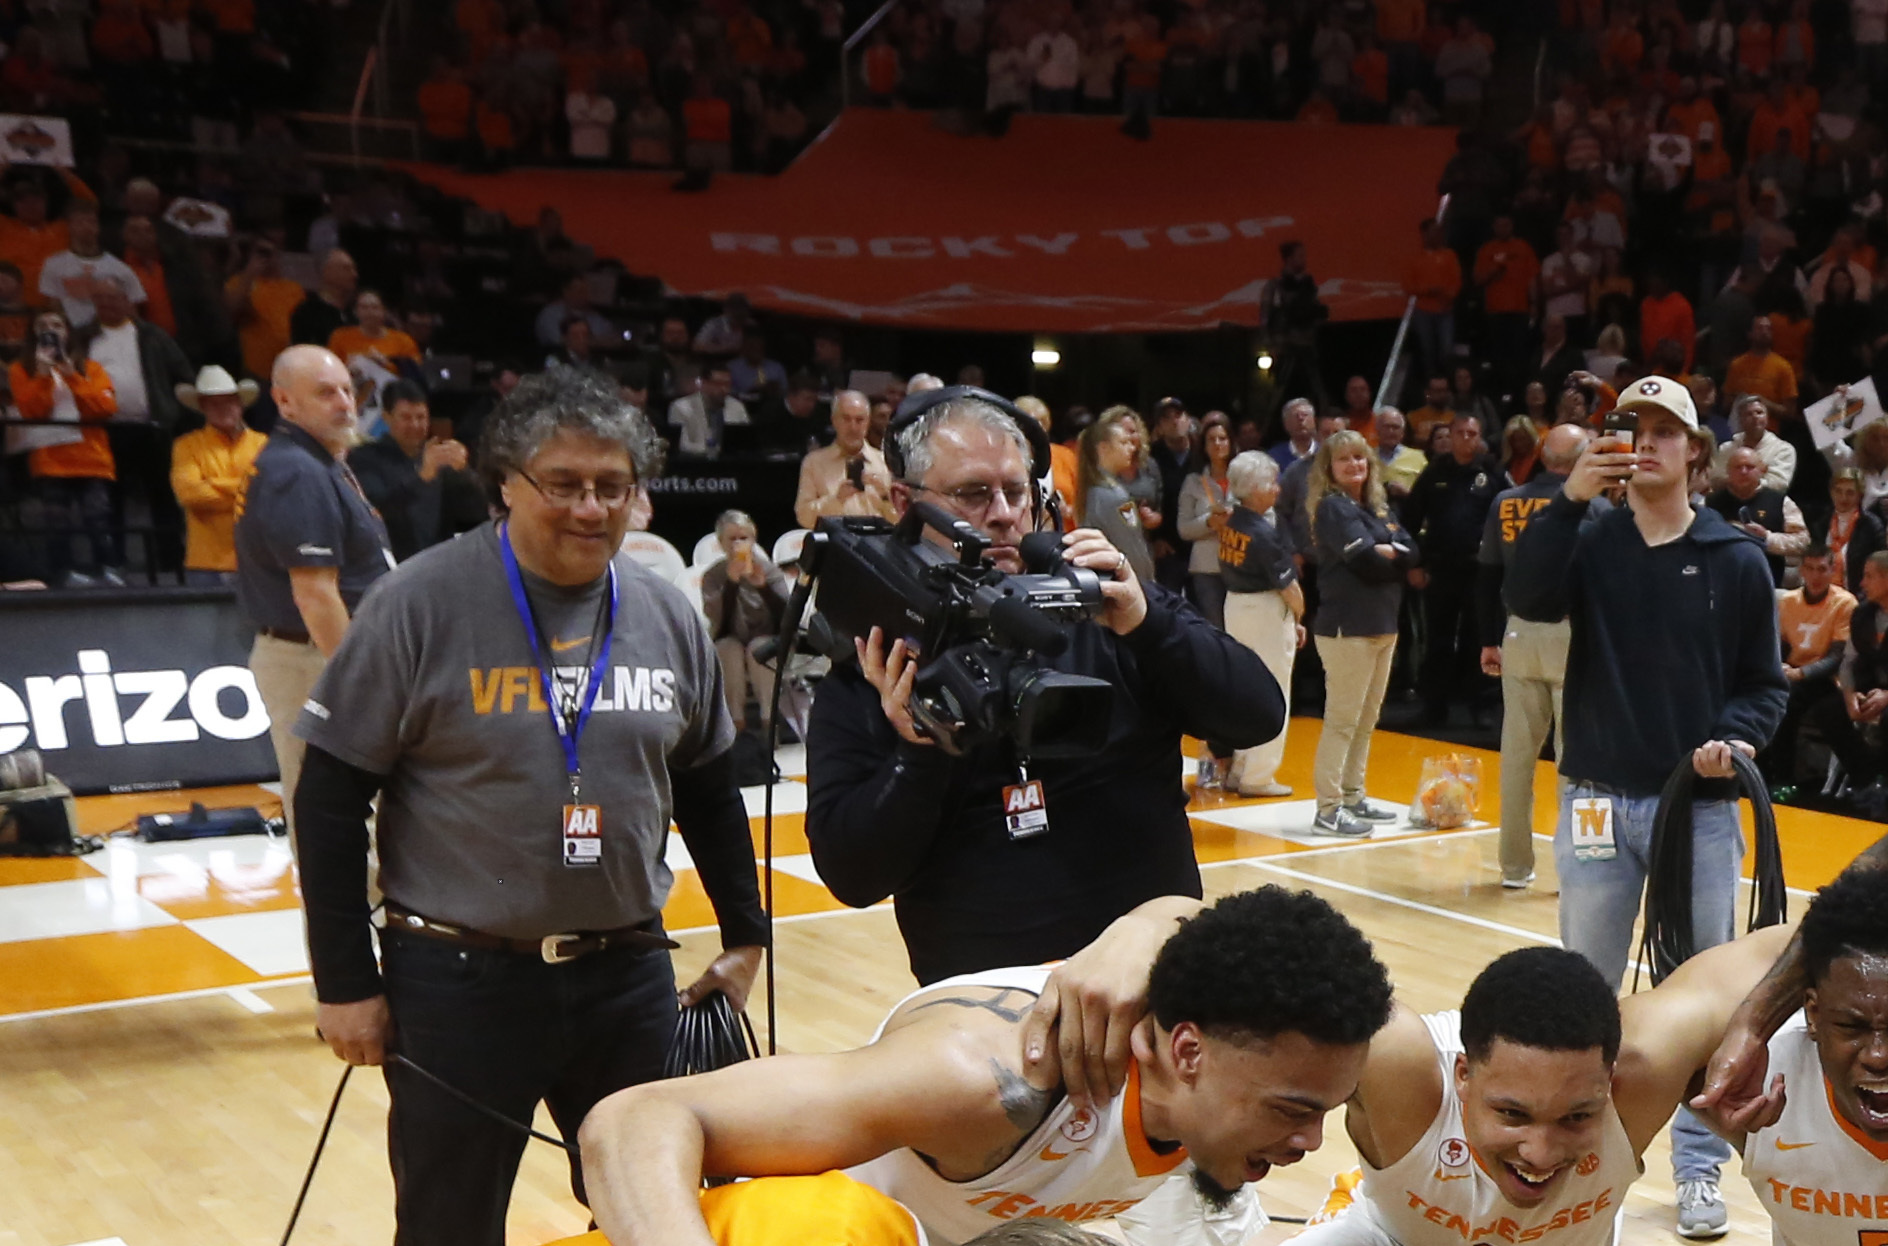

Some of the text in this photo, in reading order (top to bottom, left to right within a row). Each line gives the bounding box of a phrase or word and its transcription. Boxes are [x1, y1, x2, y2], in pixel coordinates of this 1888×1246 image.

[710, 216, 1294, 258] ROCKY TOP
[1008, 784, 1040, 812] AA
[567, 807, 598, 834] AA
[1406, 1187, 1613, 1245] TENNESSEE
